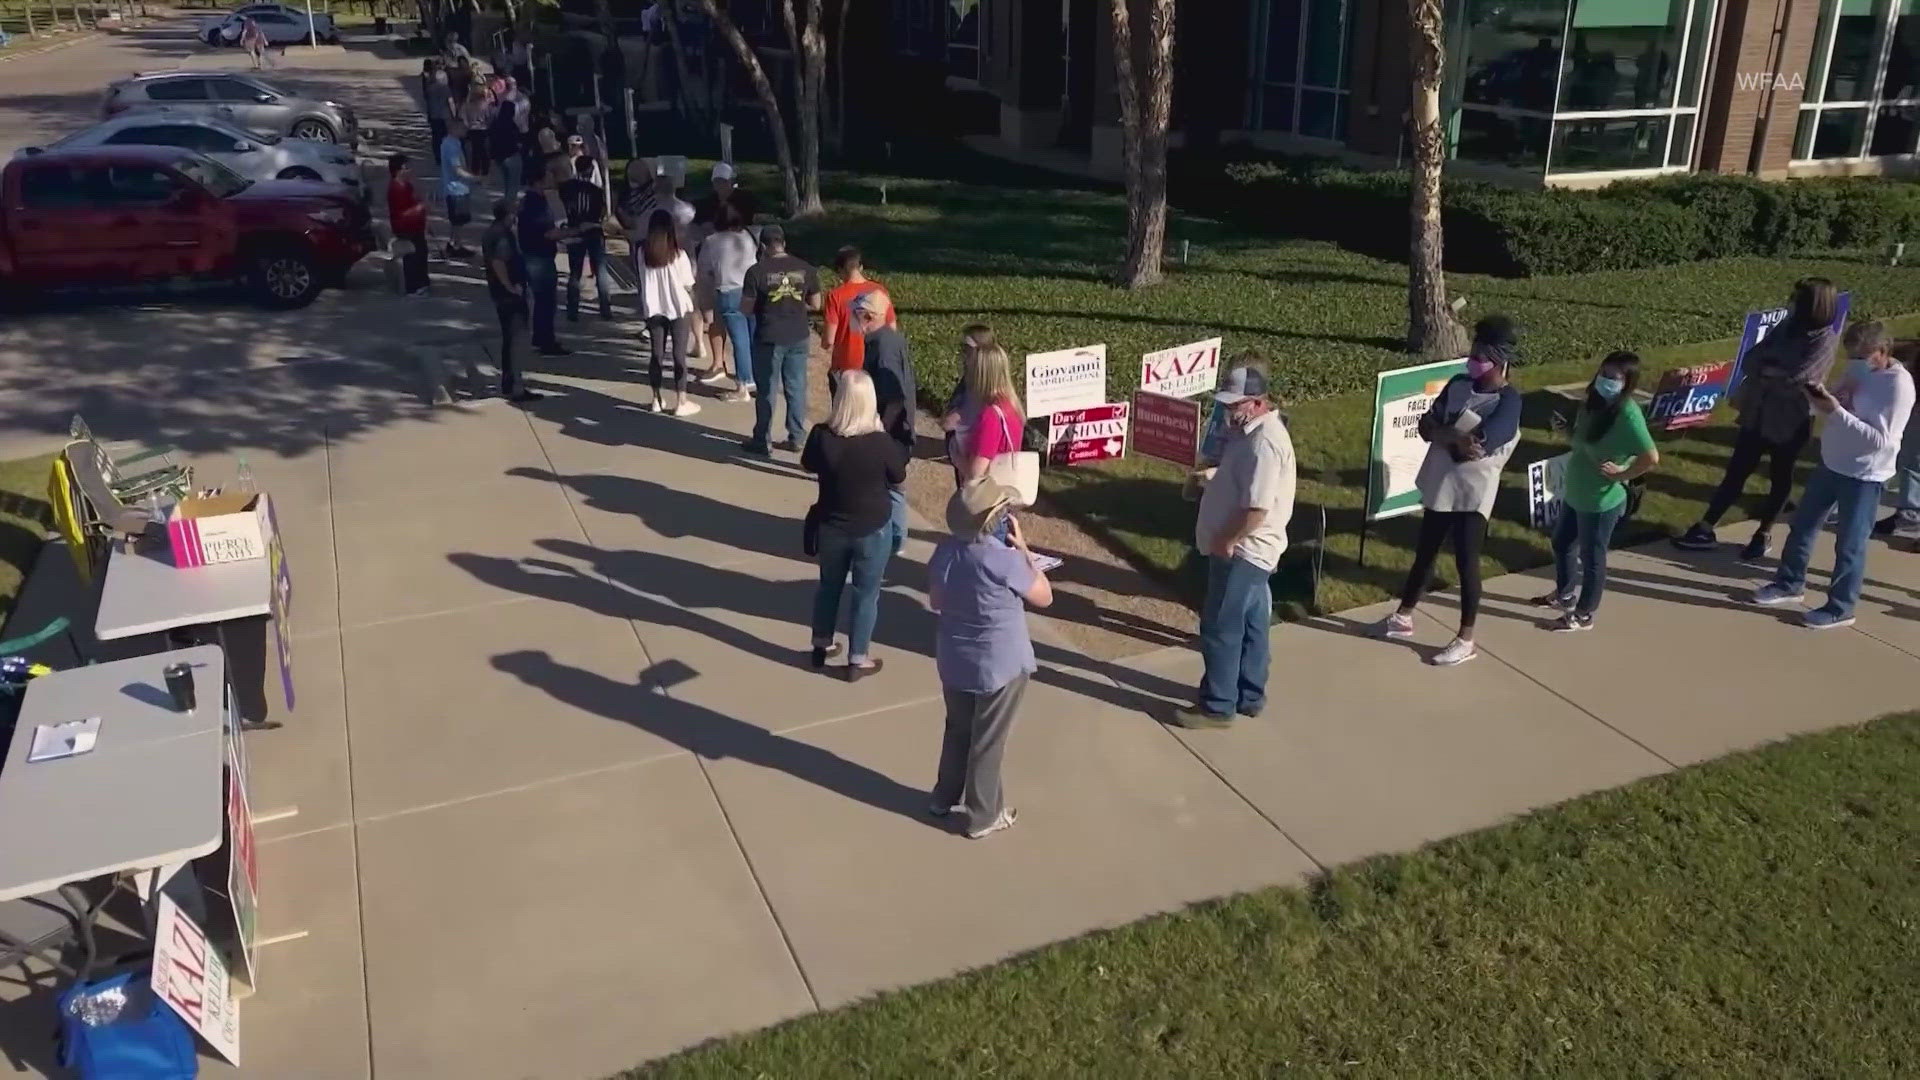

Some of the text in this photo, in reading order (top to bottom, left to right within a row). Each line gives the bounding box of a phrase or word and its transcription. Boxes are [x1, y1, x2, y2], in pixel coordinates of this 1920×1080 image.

[1031, 356, 1100, 379] Giovanni
[1144, 346, 1218, 385] KAZI
[1407, 399, 1427, 412] FACE
[1650, 387, 1718, 418] Fickes
[1054, 410, 1086, 425] David
[1392, 413, 1422, 428] REQUIR
[1051, 420, 1124, 442] TASHMAN
[168, 906, 206, 1030] KAZI
[207, 955, 223, 1021] KELLER
